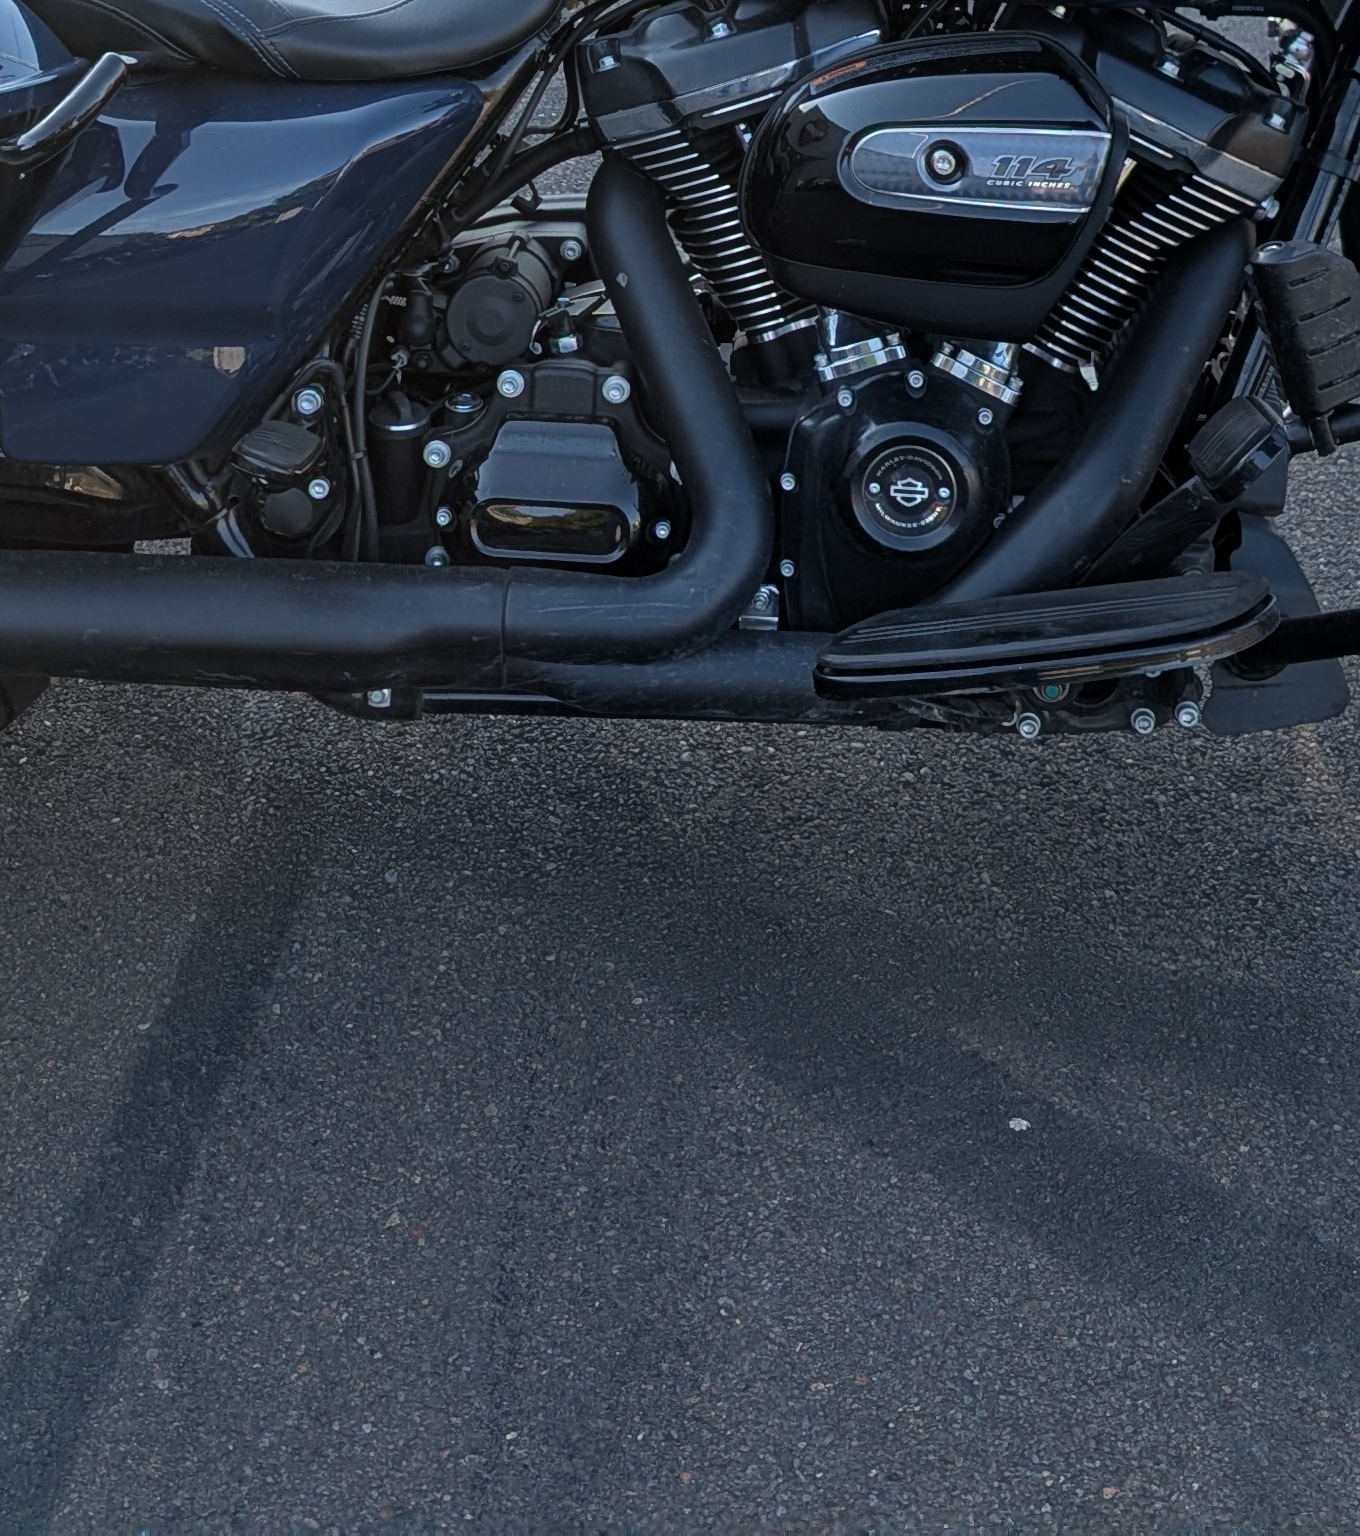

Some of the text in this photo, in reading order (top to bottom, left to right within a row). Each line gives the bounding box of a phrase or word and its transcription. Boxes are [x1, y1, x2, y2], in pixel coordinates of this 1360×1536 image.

[990, 154, 1076, 181] 114
[986, 179, 1071, 189] CUBIC INCHES
